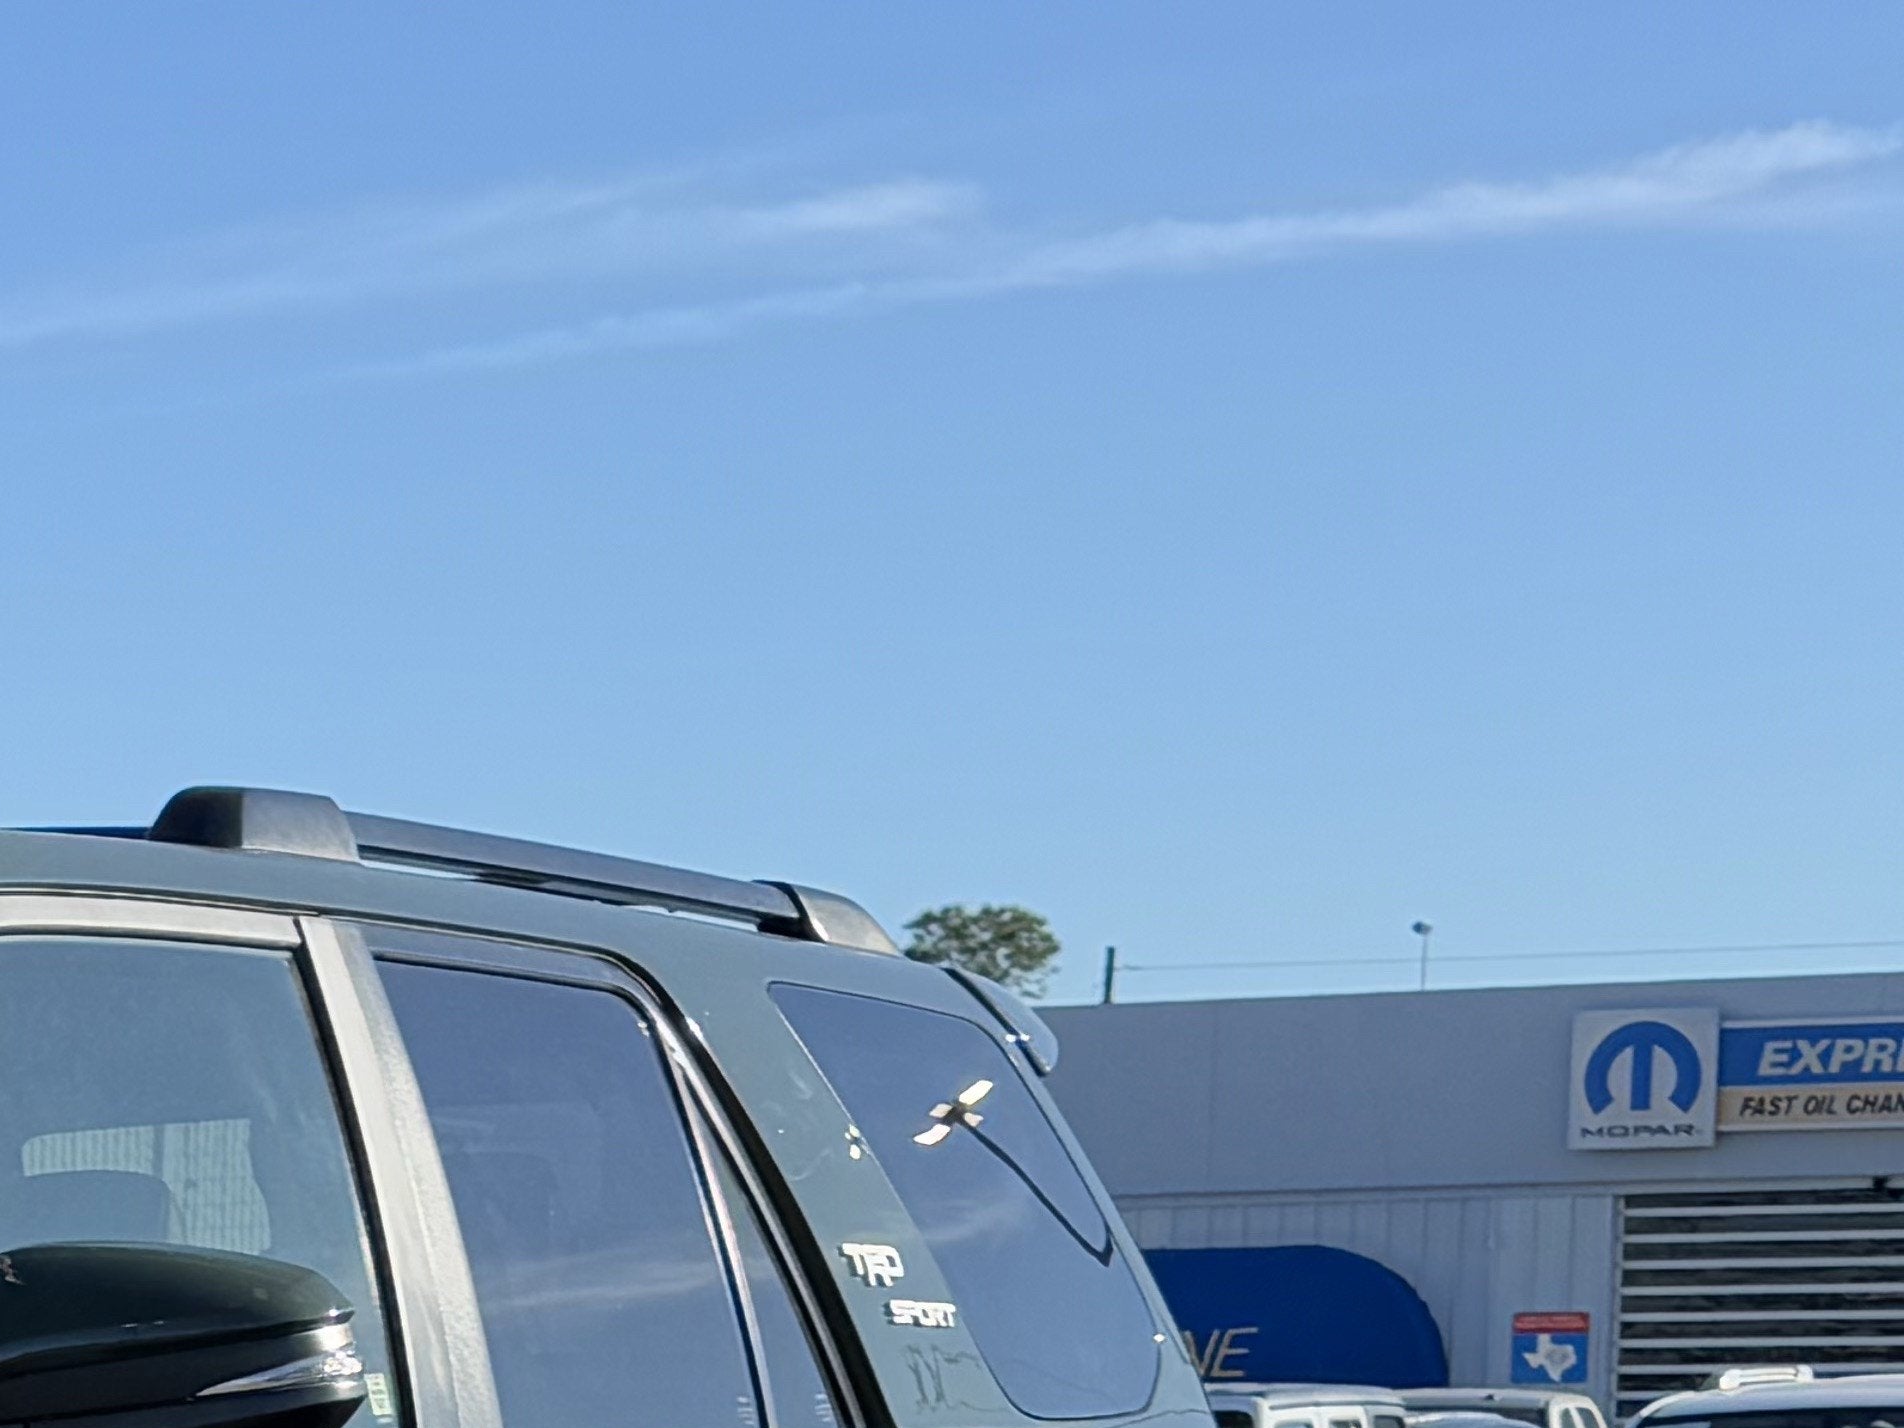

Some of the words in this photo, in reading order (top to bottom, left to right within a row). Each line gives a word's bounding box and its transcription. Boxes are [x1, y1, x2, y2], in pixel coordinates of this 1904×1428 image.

[1739, 1094, 1794, 1118] FAST
[1802, 1094, 1838, 1117] OIL
[1579, 1123, 1696, 1139] MOPAR
[841, 1242, 905, 1287] TRD
[889, 1299, 957, 1328] SPORT
